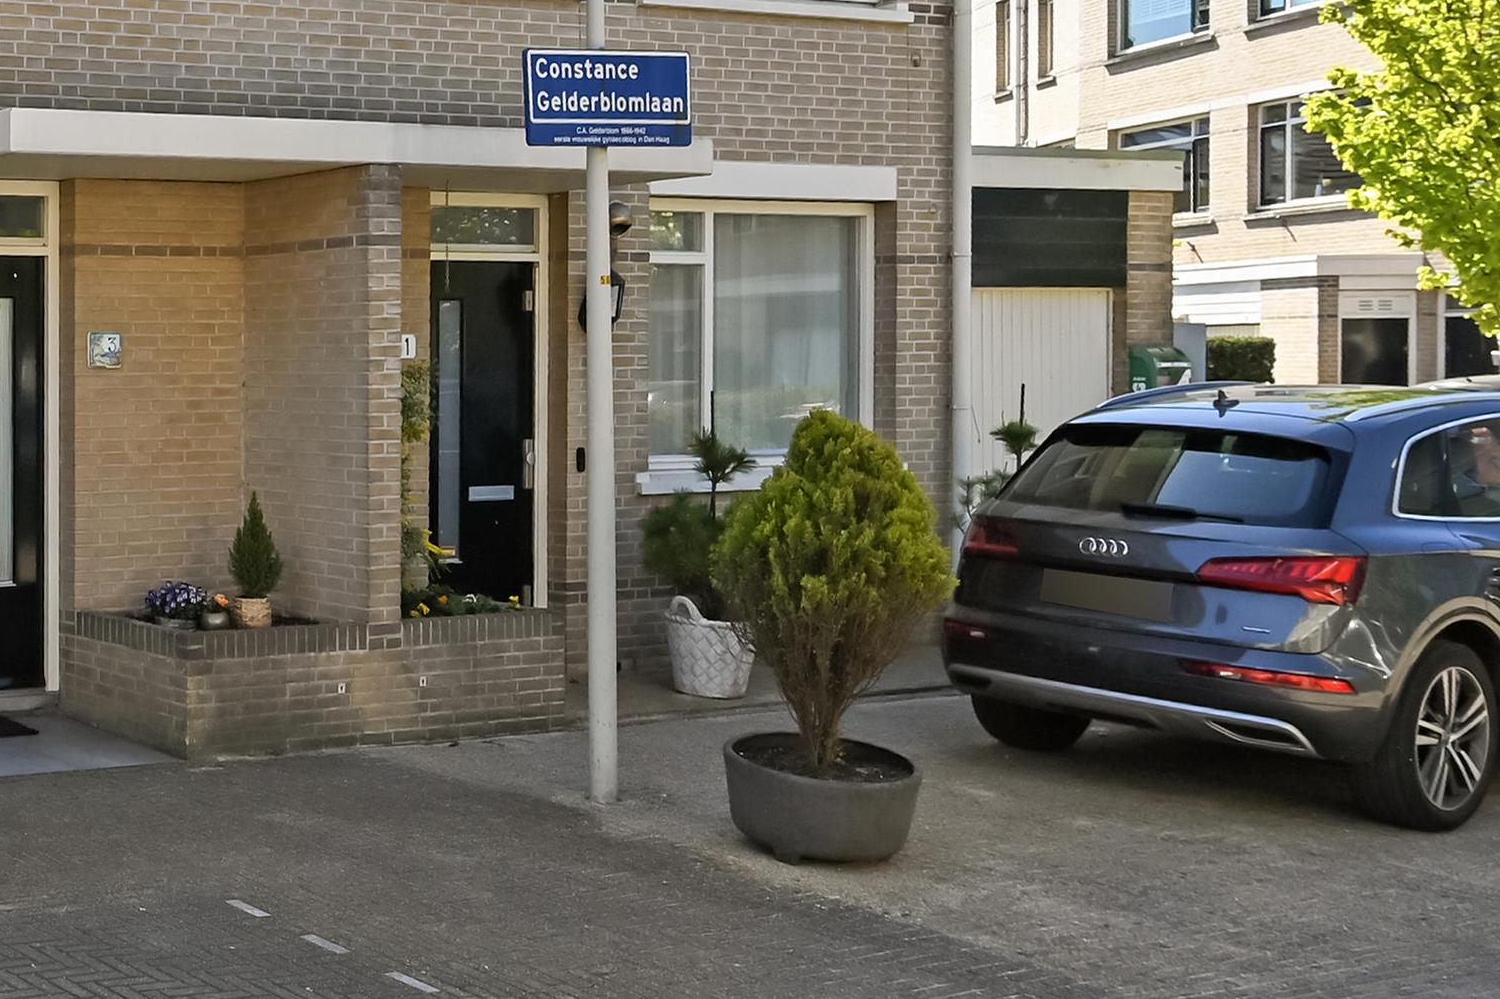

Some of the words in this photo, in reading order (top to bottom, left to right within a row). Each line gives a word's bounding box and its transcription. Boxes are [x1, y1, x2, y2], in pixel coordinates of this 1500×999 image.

[535, 57, 639, 79] Constance
[537, 90, 684, 113] Gelderblomlaan
[107, 337, 117, 353] 3
[405, 337, 410, 356] 1
